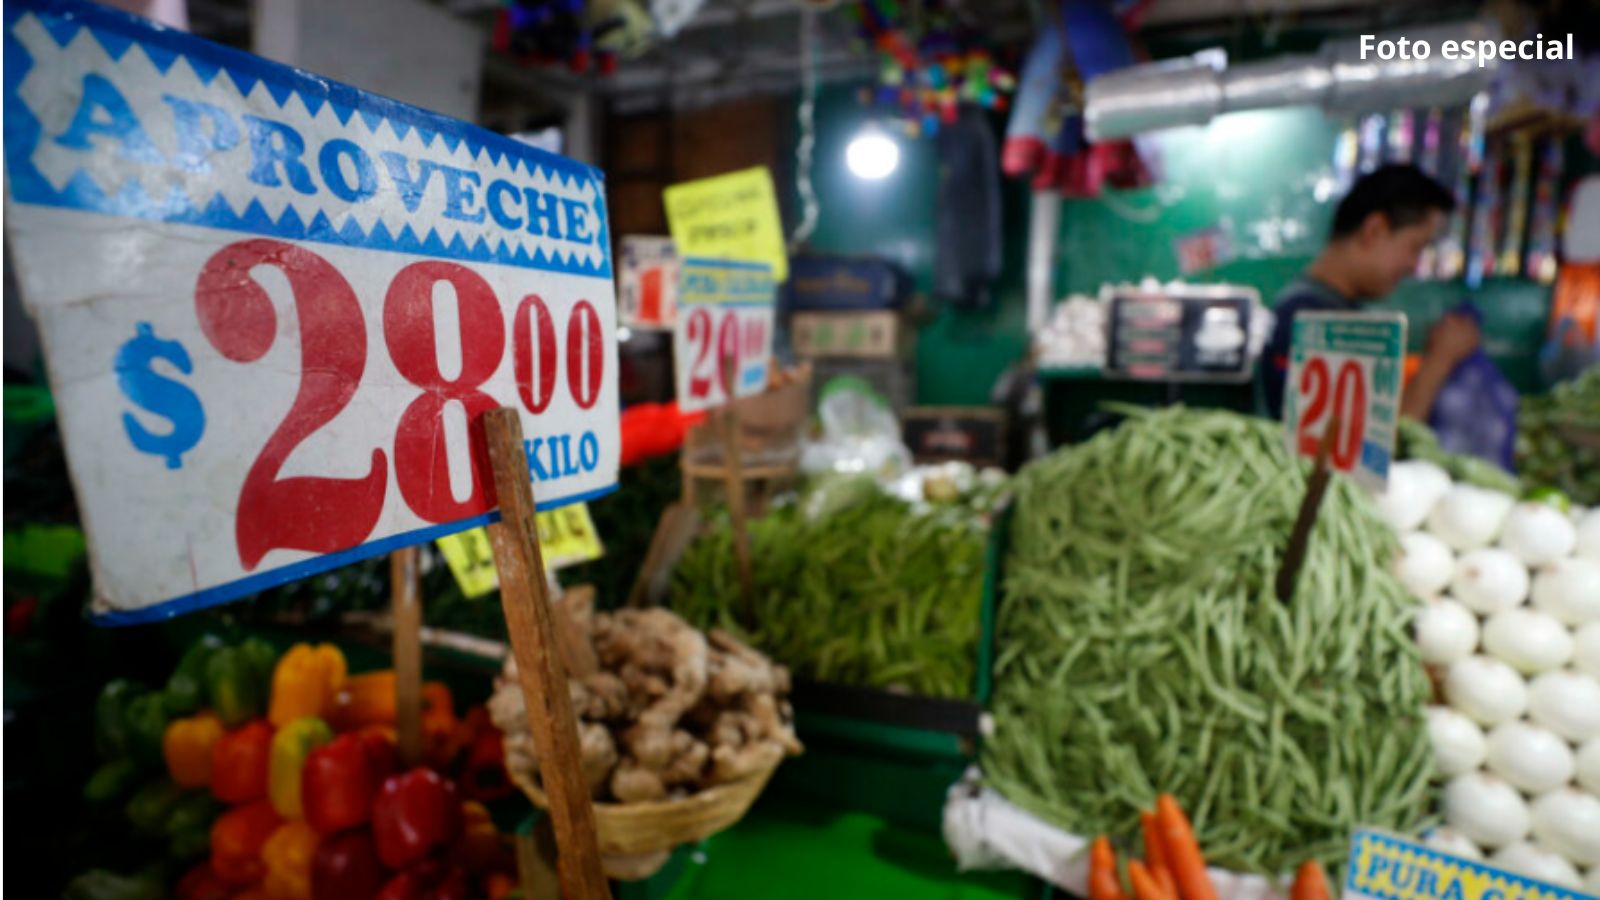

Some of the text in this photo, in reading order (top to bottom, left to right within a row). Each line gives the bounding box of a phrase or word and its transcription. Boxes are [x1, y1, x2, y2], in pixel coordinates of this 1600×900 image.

[53, 72, 594, 246] APROVECHE
[523, 430, 600, 483] KILO
[1297, 356, 1366, 473] 20
